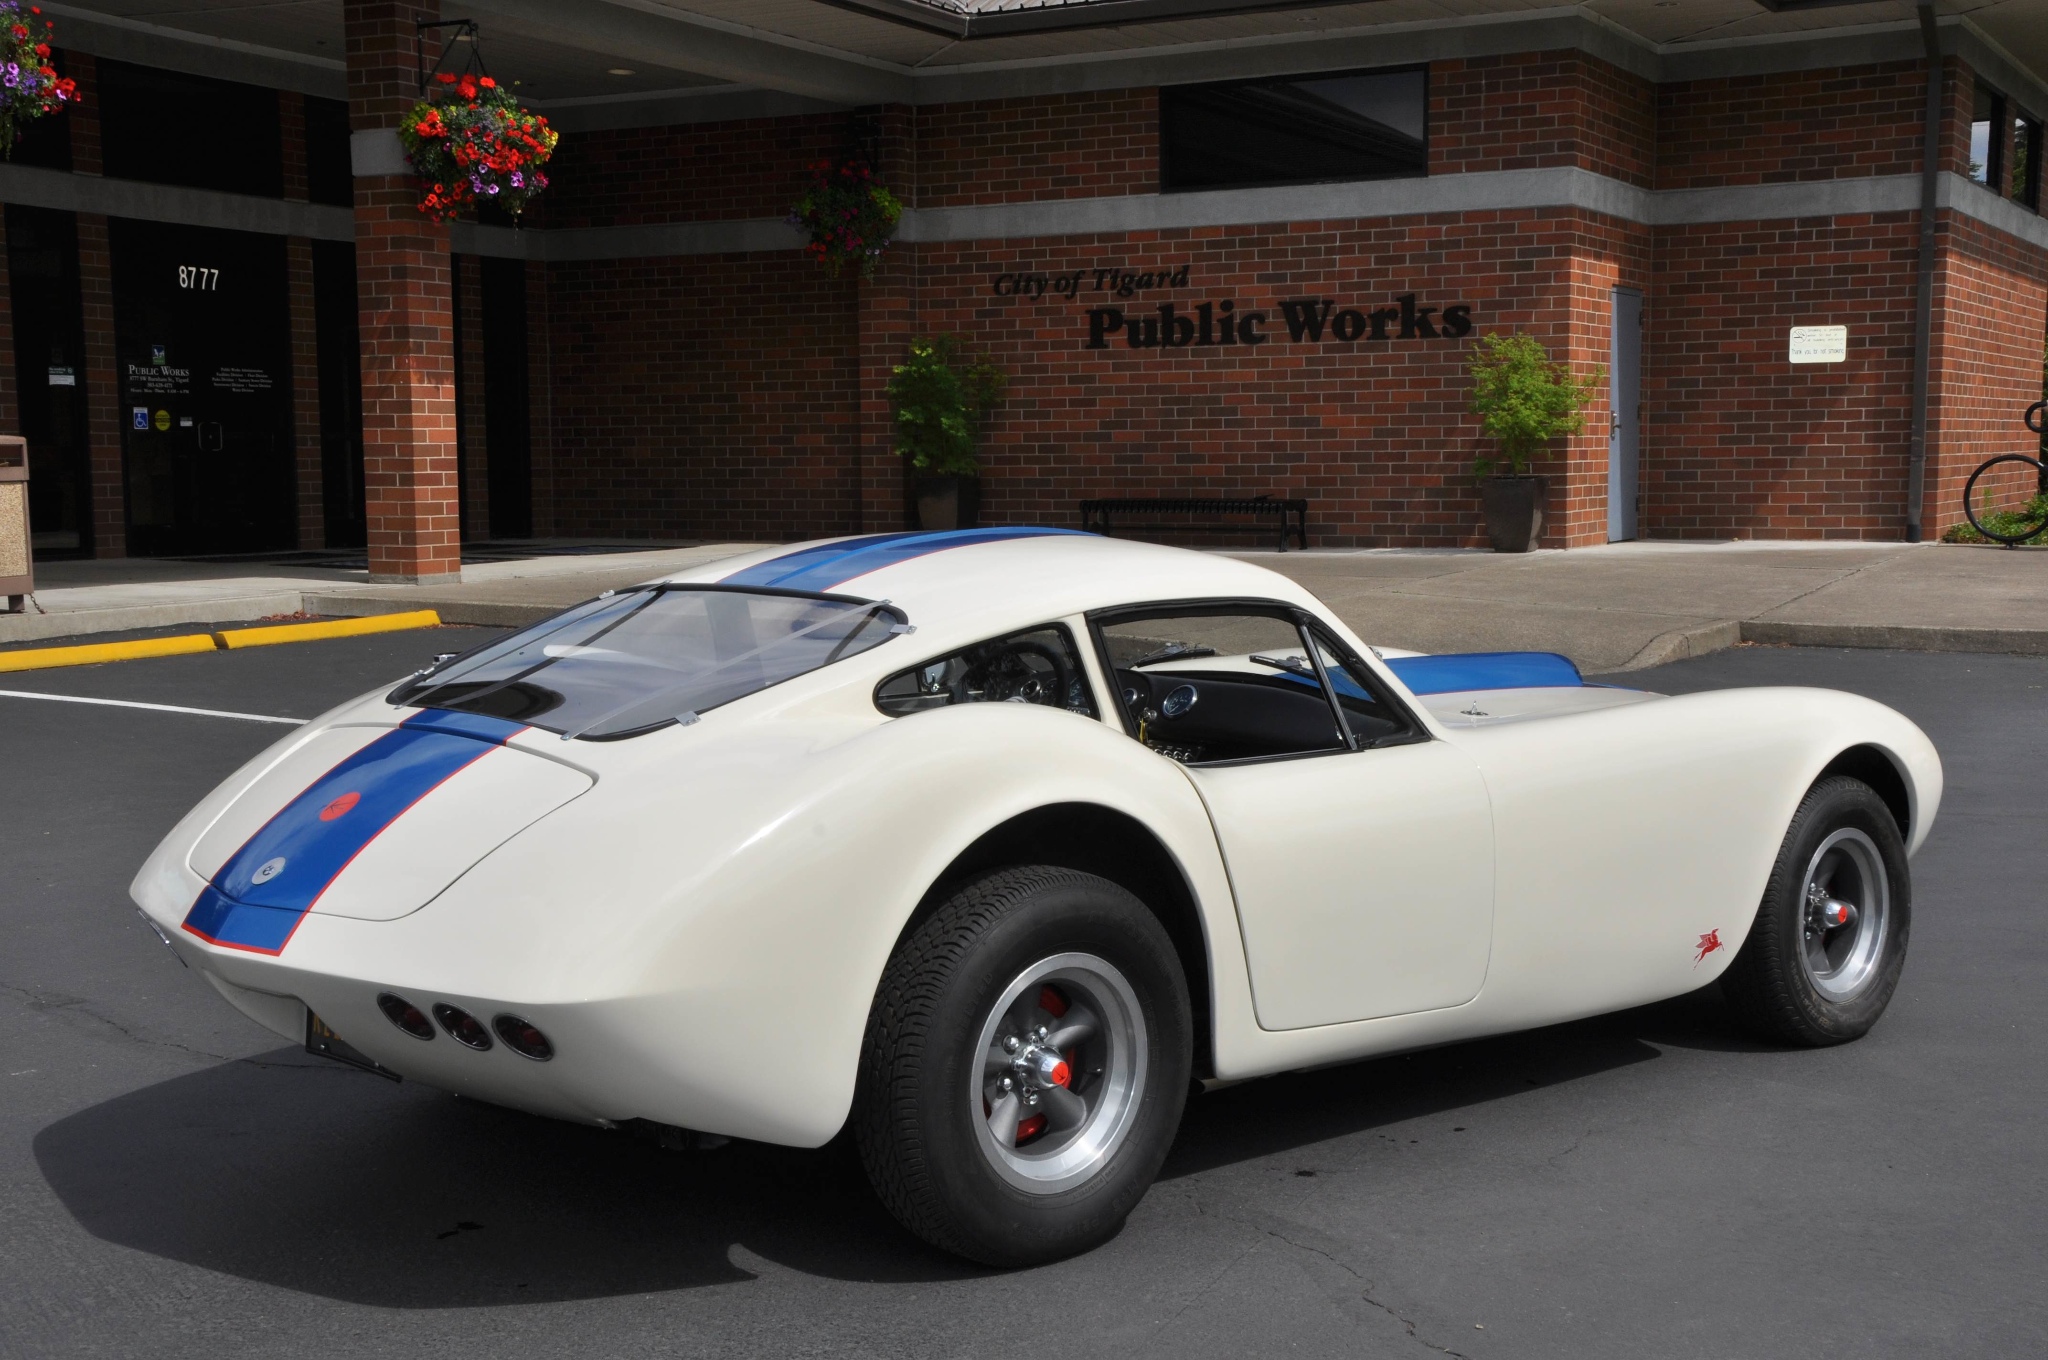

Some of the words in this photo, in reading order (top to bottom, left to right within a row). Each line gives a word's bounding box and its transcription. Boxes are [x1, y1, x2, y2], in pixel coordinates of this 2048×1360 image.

[178, 265, 219, 290] 8777
[993, 272, 1049, 300] City
[1054, 269, 1086, 299] of
[1092, 265, 1190, 298] Tigard
[1084, 300, 1266, 349] Public
[1277, 293, 1472, 343] Works
[128, 364, 159, 375] PUBLIC
[160, 366, 190, 376] WORKS
